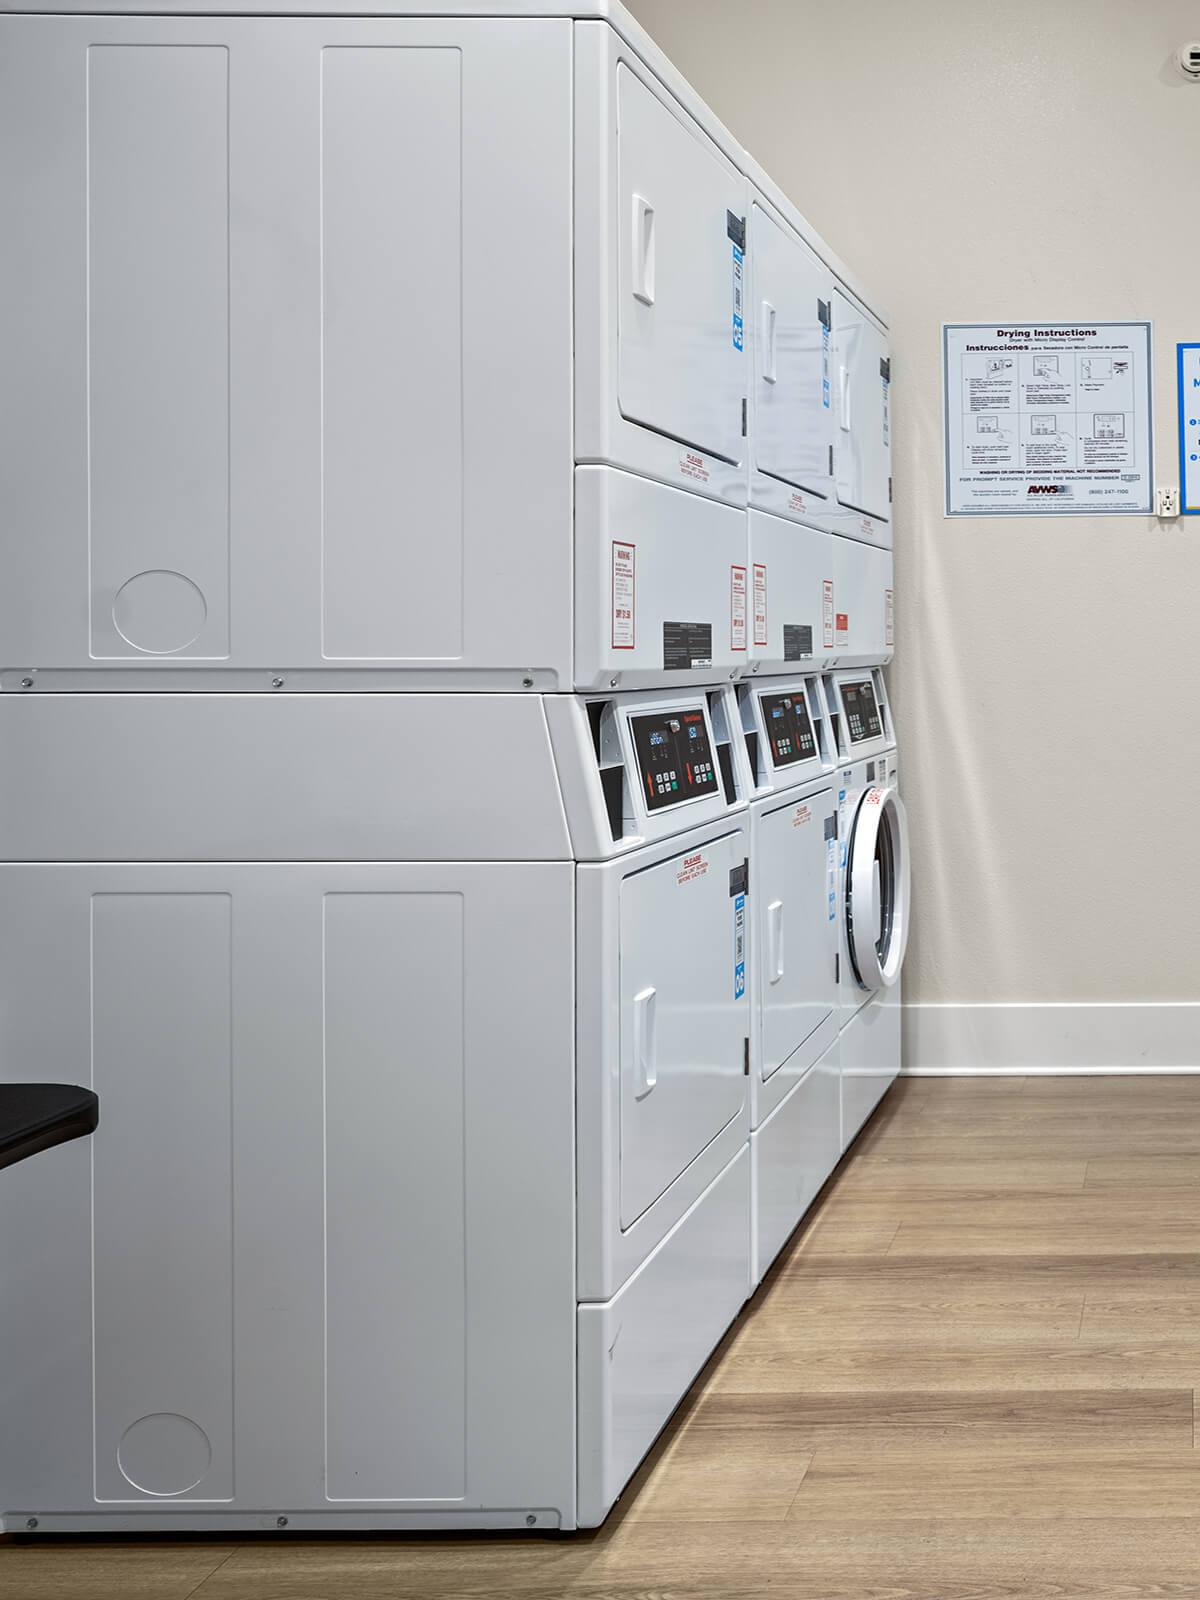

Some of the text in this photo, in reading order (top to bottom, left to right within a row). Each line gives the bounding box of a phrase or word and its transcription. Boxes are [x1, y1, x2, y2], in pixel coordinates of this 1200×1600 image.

[997, 329, 1097, 338] Drying Instructions
[1027, 485, 1058, 494] AVWS
[684, 854, 701, 866] PLEASE
